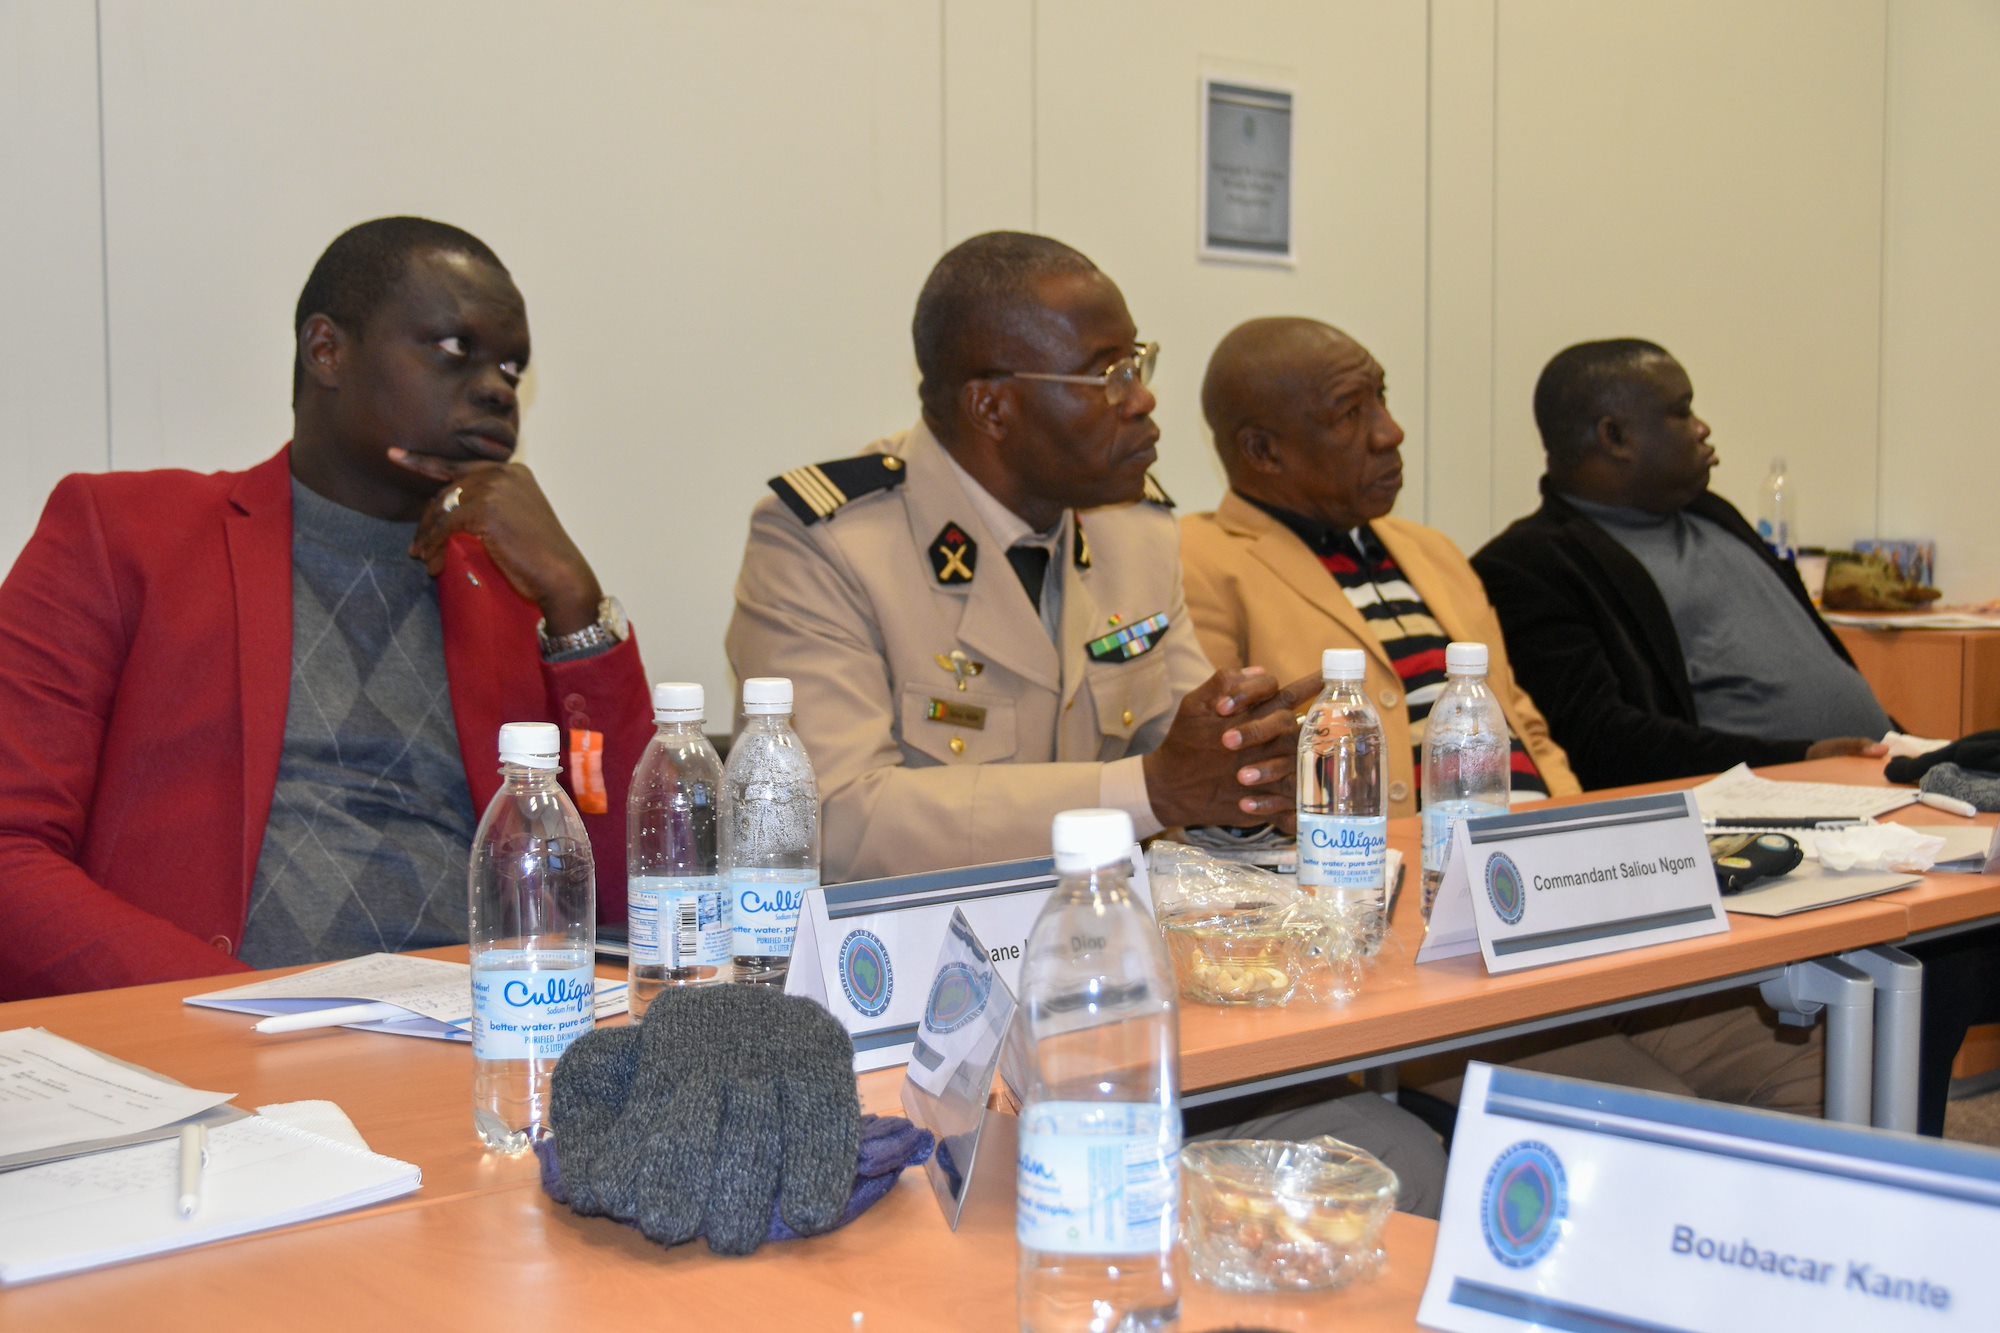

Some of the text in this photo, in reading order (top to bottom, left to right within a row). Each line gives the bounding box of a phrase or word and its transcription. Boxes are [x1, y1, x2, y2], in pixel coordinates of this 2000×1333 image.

[1311, 829, 1386, 857] Culligan
[1349, 861, 1365, 869] pure
[1533, 856, 1697, 891] Commandant Saliou Ngom
[740, 889, 801, 913] Culli
[731, 925, 797, 934] etter water. pu
[991, 945, 1020, 962] ane
[490, 1020, 518, 1032] better
[522, 1023, 556, 1032] water.
[559, 1018, 579, 1032] pure
[580, 1013, 591, 1024] and
[525, 1034, 555, 1044] PRIFIED
[540, 1045, 550, 1054] 0.5
[1670, 1223, 1952, 1311] Boubacar Kante
